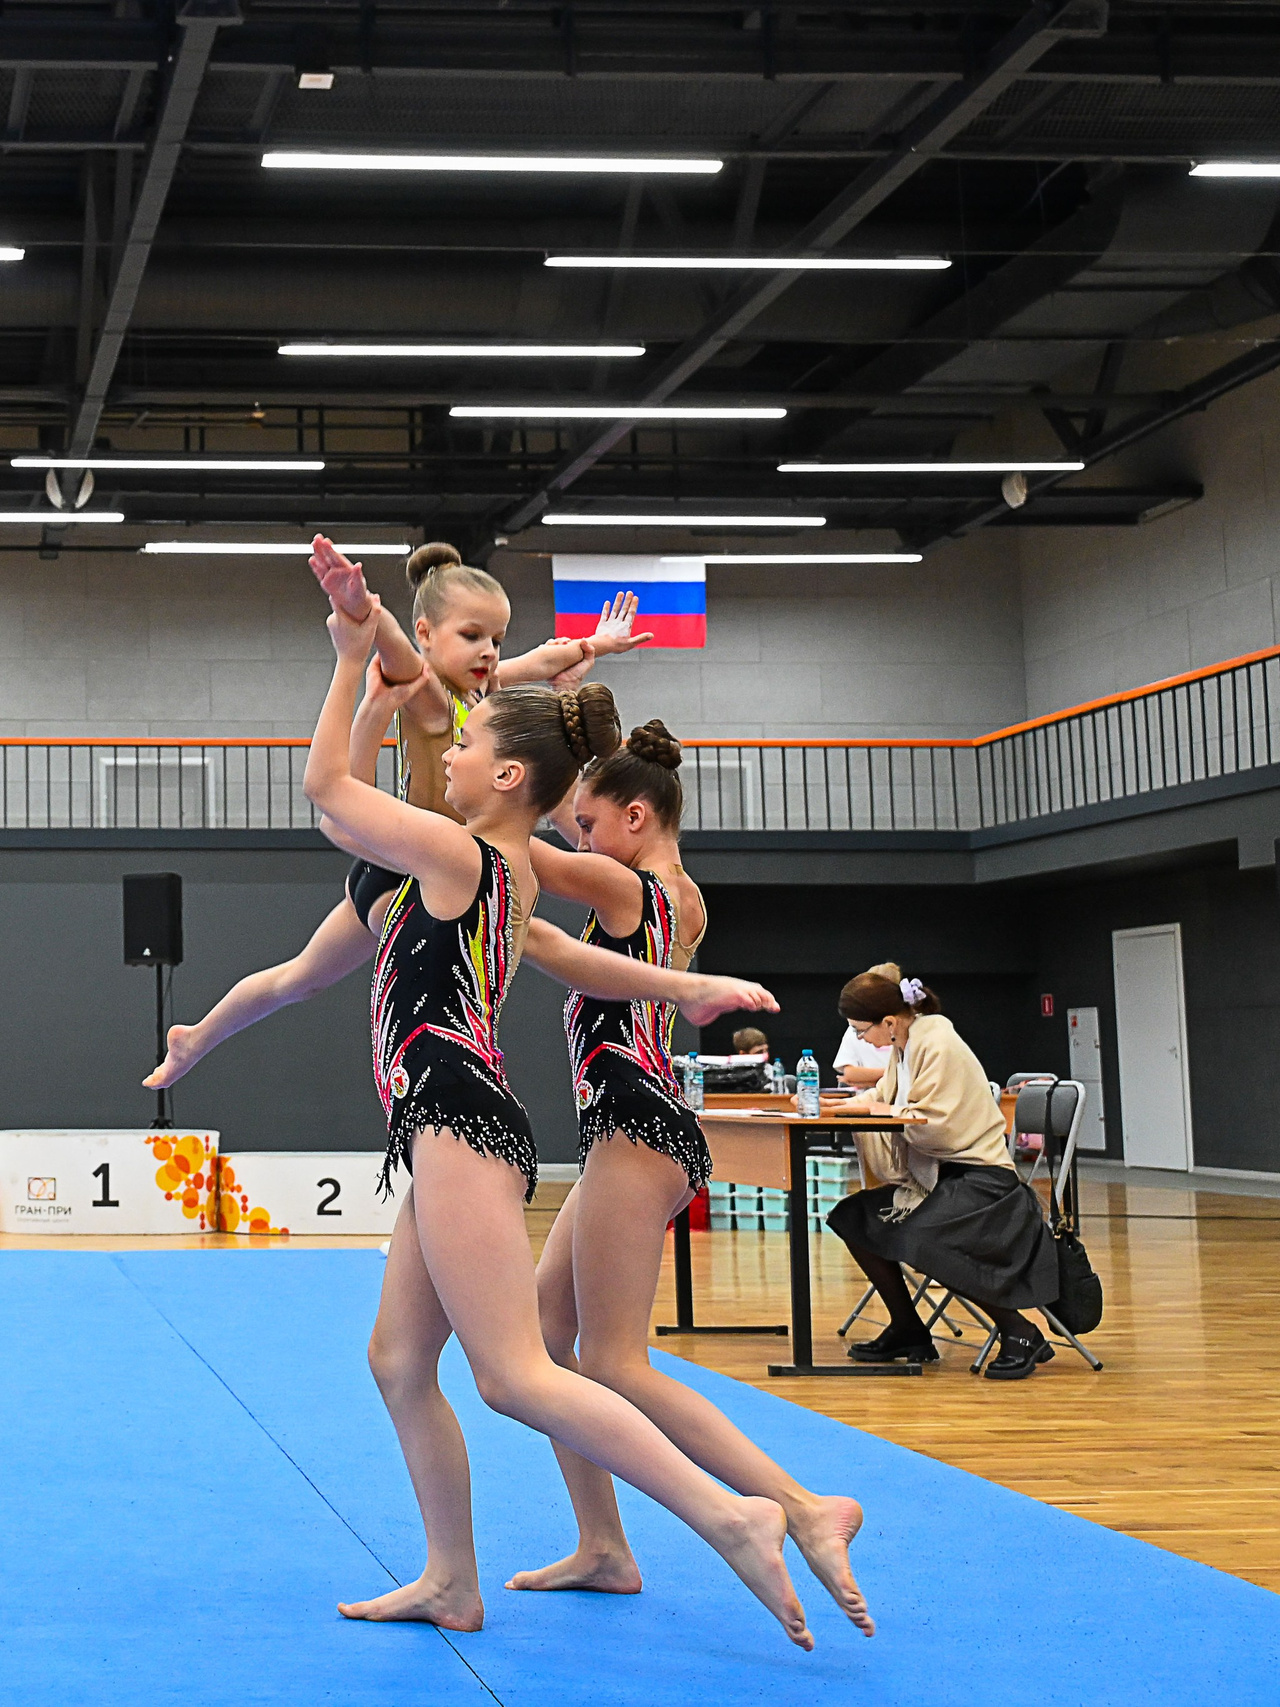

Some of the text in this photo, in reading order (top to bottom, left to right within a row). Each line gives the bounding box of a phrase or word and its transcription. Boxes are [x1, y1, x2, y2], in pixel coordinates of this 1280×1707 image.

[92, 1162, 119, 1208] 1
[316, 1177, 342, 1216] 2
[14, 1204, 72, 1216] ГРАН-ПРИ
